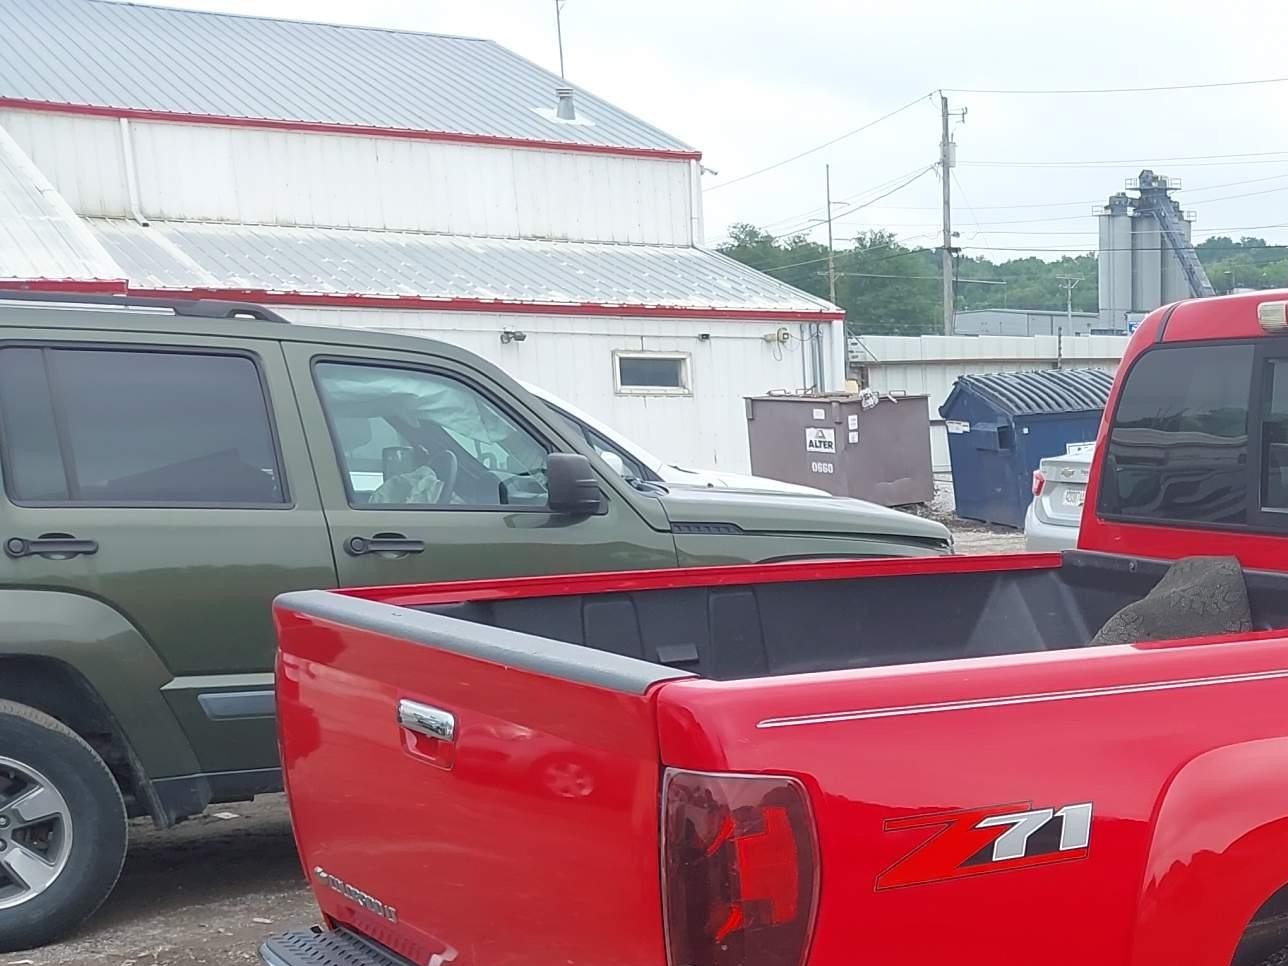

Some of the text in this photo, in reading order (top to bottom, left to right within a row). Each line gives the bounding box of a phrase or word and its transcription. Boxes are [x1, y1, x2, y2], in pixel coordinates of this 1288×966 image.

[808, 440, 834, 449] ALTER
[811, 461, 834, 473] 0660
[874, 801, 1093, 892] Z71
